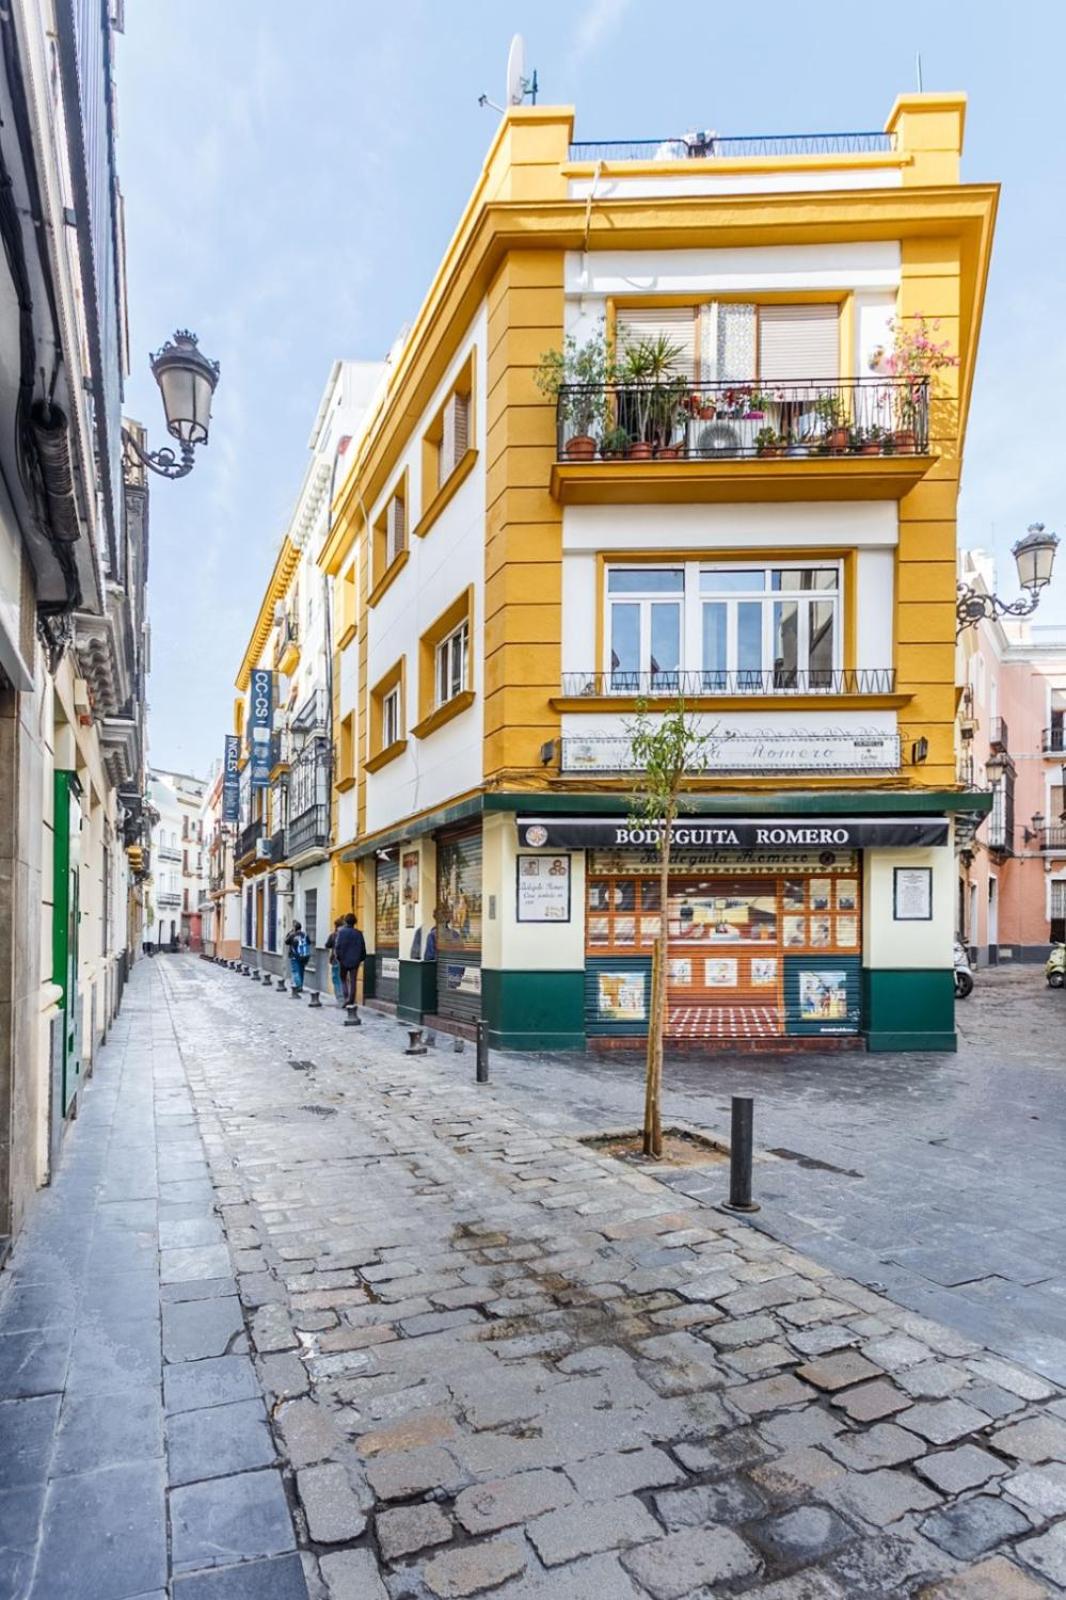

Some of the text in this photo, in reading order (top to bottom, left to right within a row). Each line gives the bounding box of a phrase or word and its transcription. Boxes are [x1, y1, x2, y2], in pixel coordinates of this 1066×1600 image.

[255, 672, 269, 718] CC-CS
[615, 829, 849, 845] BODEGUITA ROMERO
[640, 851, 728, 867] Bdeguita
